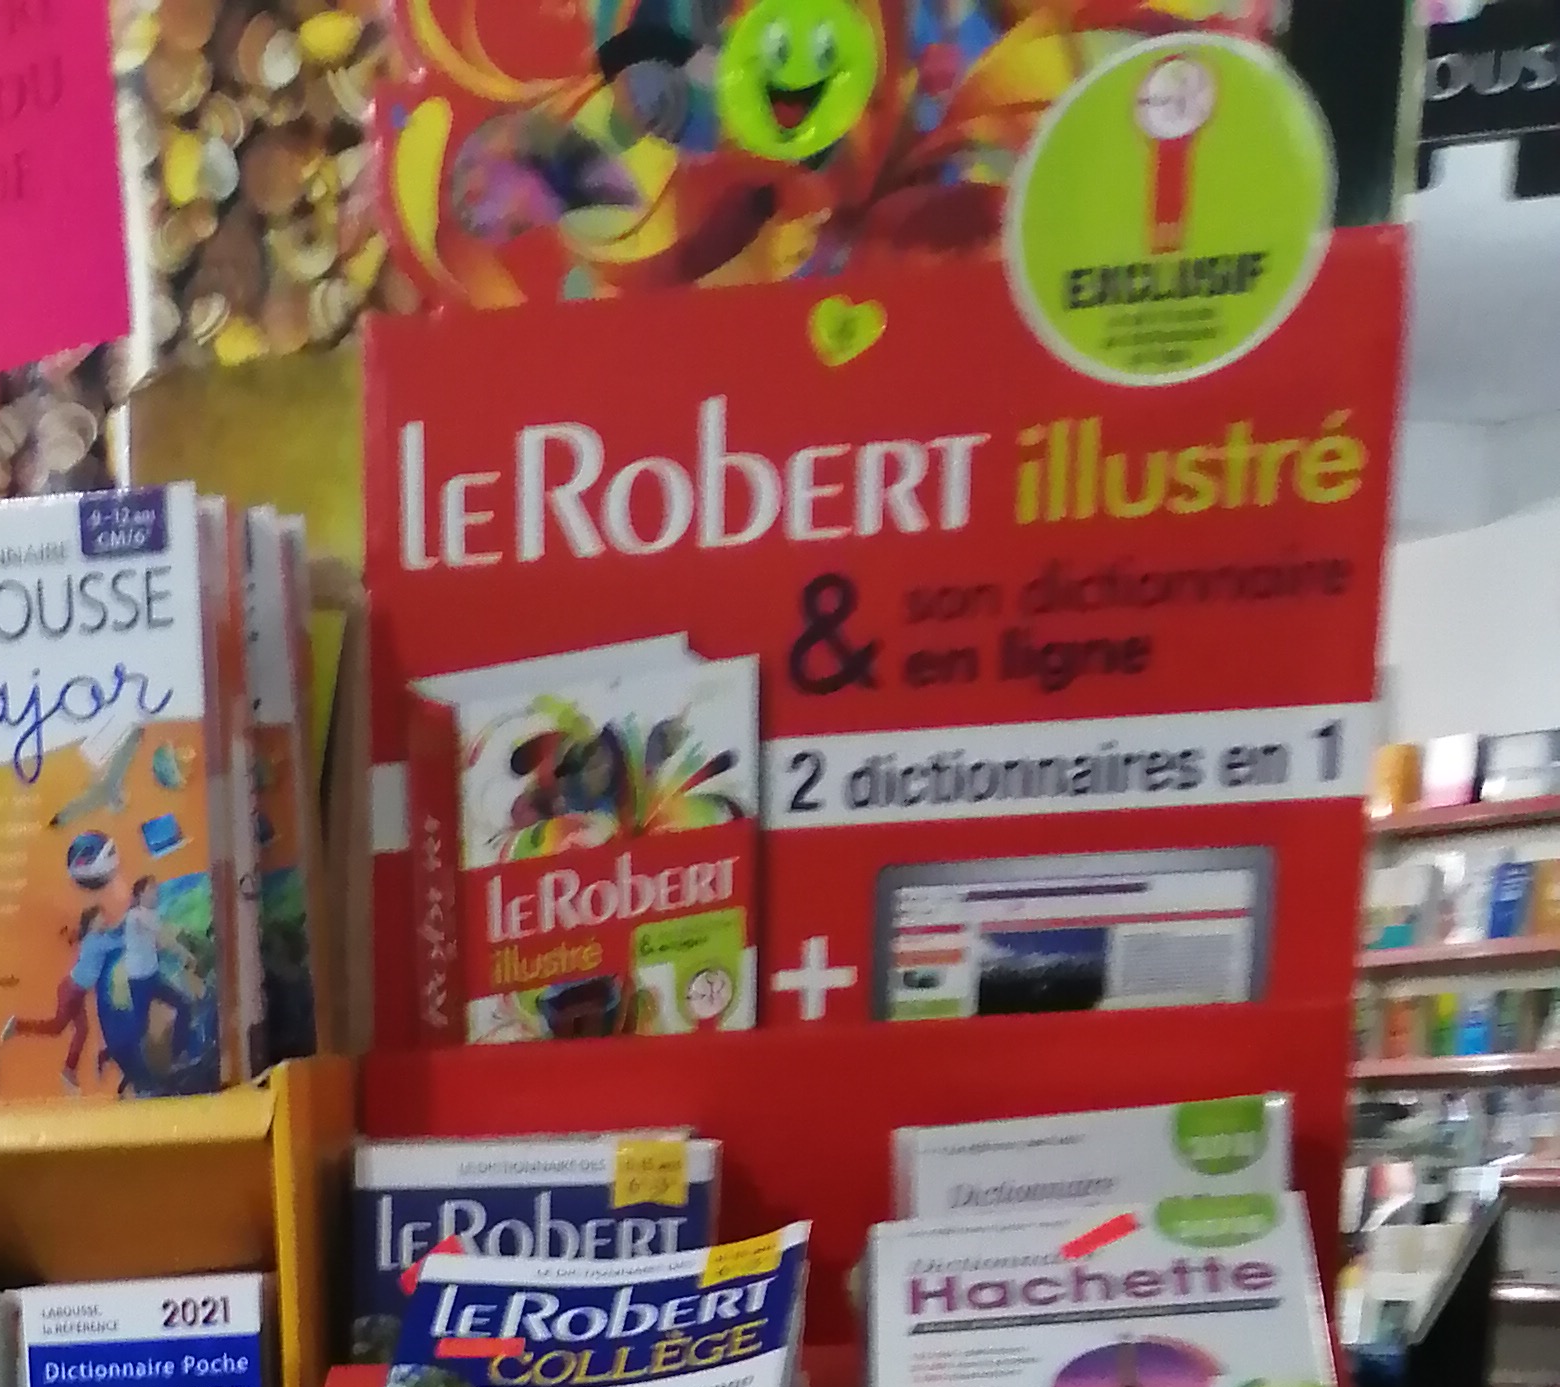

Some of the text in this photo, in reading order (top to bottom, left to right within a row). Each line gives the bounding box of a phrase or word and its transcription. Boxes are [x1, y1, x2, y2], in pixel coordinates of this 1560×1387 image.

[1017, 410, 1366, 527] illustré
[906, 627, 1151, 694] en ligne
[786, 721, 1344, 814] 2 dictionnaires en 1
[160, 1296, 231, 1330] 2021
[908, 1256, 1276, 1316] Hachette
[44, 1352, 249, 1385] Dictionnaire Poche
[488, 1318, 770, 1387] COLLÈGE
